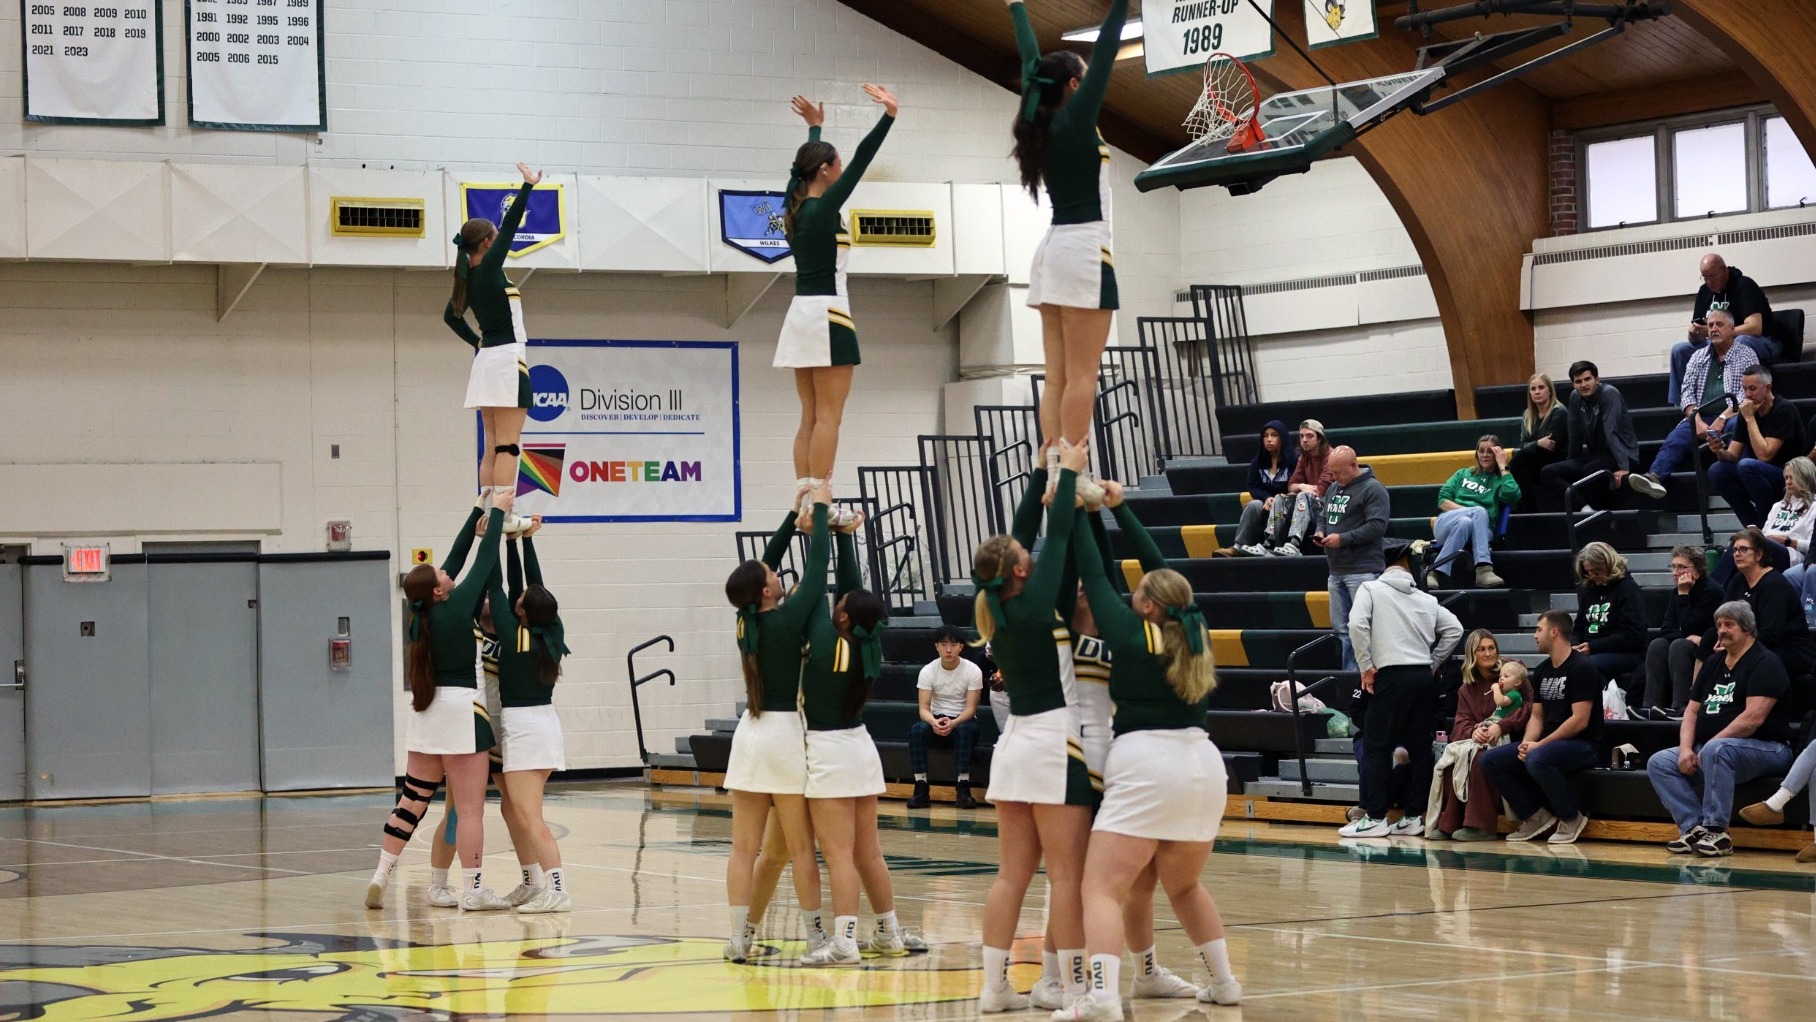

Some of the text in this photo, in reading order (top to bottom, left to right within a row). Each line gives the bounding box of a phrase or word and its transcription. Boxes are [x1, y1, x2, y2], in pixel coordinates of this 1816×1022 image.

[32, 5, 147, 19] 2005 2008 2009 2010
[197, 12, 309, 27] 1991 1992 1995 1996
[1171, 0, 1239, 23] RUNNER-UP
[32, 24, 146, 39] 2011 2017 2018 2019
[196, 32, 309, 46] 2000 2002 2003 2004
[1183, 23, 1223, 55] 1989
[32, 45, 88, 57] 2021 2023
[196, 52, 279, 65] 2005 2006 2015
[580, 388, 682, 411] Division III
[581, 413, 619, 421] DISCOVER
[663, 414, 700, 422] DEDICATE
[569, 460, 702, 482] ONETEAM
[75, 549, 101, 571] EXIT
[1539, 676, 1567, 700] NIKE
[1704, 692, 1735, 703] YORK
[552, 871, 562, 892] DVU
[1073, 956, 1084, 984] DVU
[1092, 961, 1104, 990] DVU
